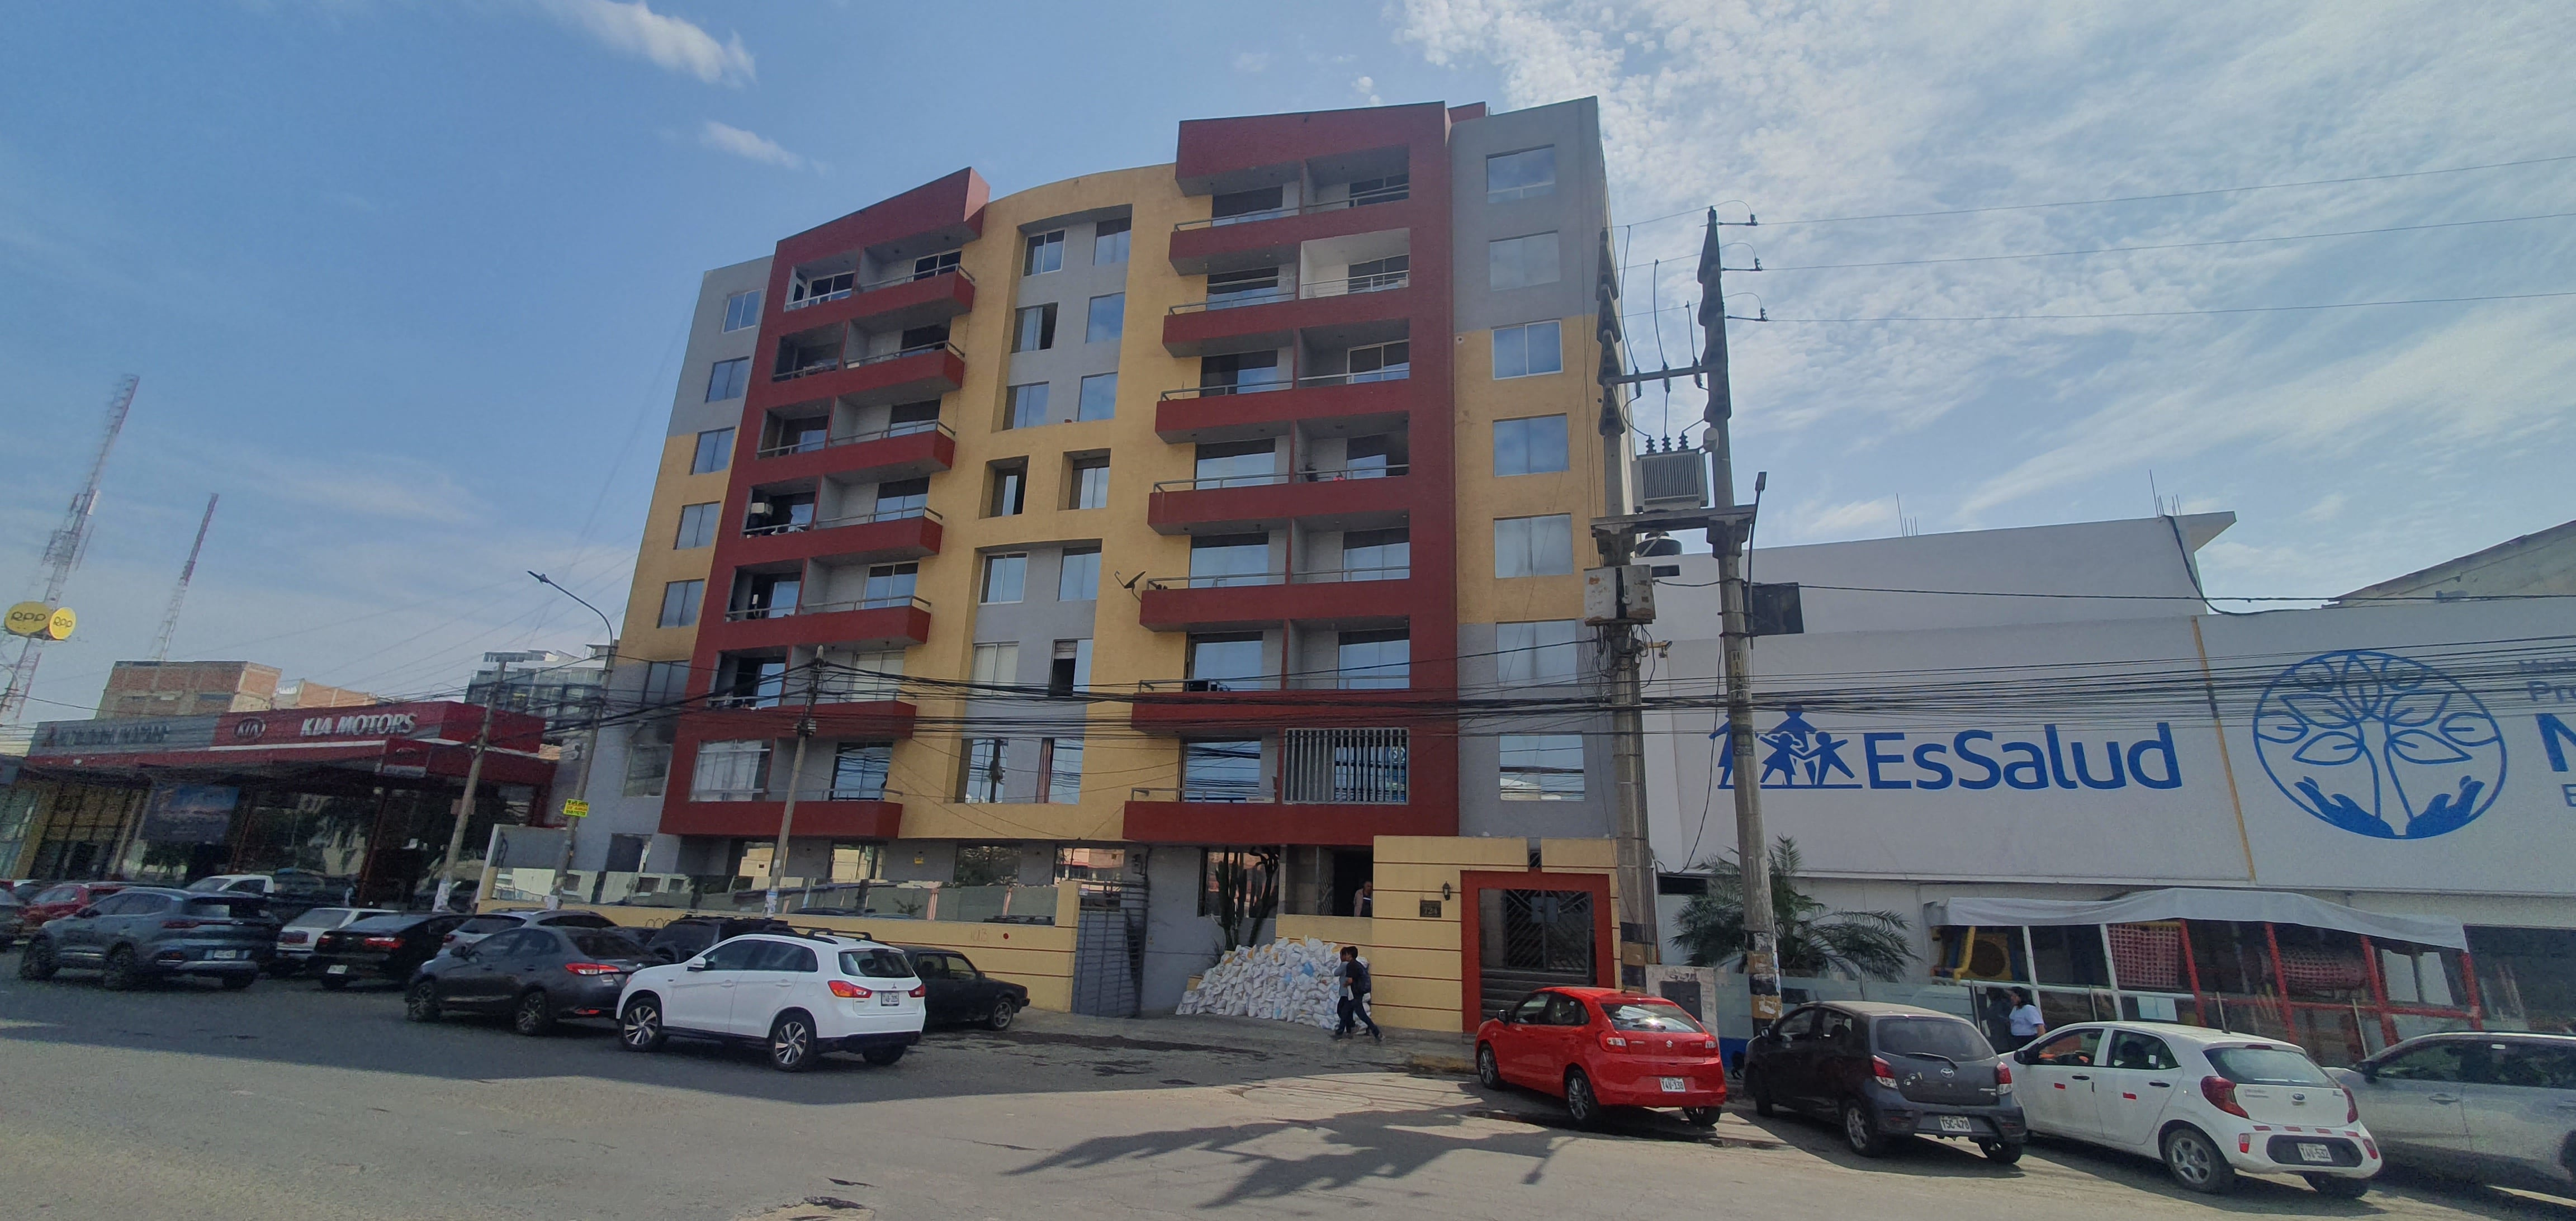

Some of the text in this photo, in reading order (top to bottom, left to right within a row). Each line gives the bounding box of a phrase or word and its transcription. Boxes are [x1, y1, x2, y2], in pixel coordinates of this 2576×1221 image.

[237, 722, 264, 737] KIA
[300, 713, 417, 736] KIA MOTORS
[1863, 722, 2182, 790] EsSalud
